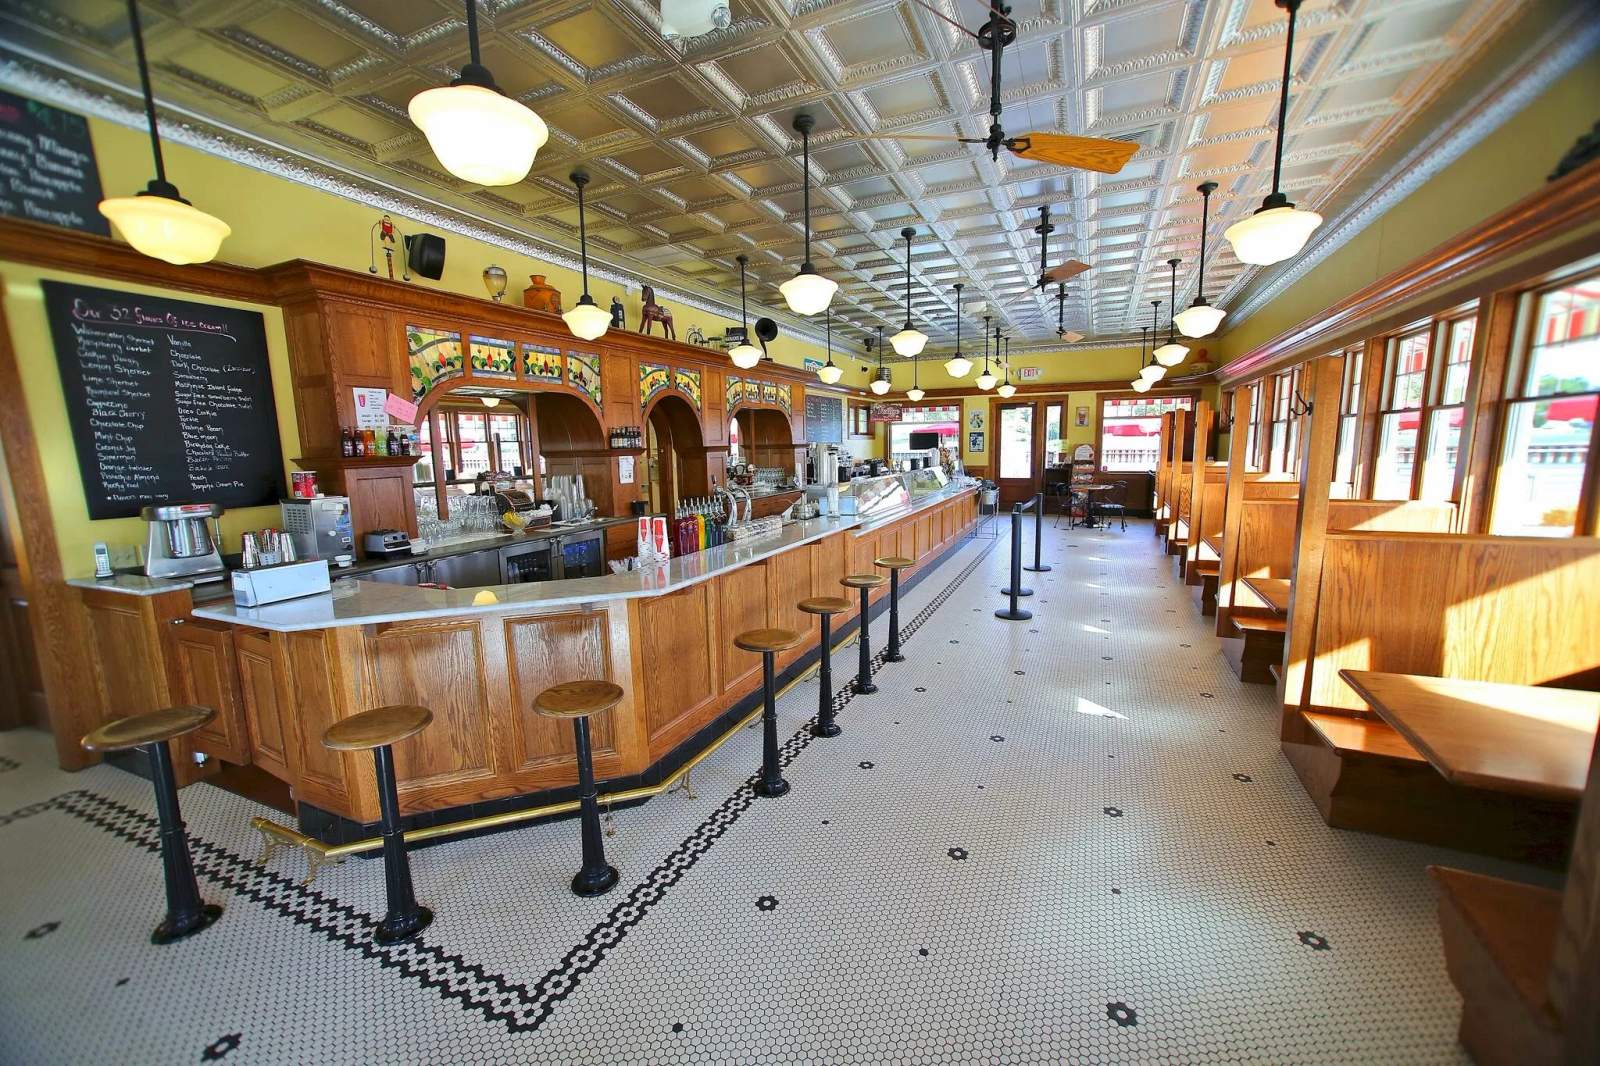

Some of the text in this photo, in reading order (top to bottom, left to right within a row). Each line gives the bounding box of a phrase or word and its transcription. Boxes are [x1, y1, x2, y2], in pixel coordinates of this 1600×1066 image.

[166, 333, 192, 347] Vanilla
[170, 349, 202, 362] Chocolate
[1023, 368, 1035, 377] EXIT
[92, 407, 146, 421] Black Cherry
[188, 474, 208, 484] Peach
